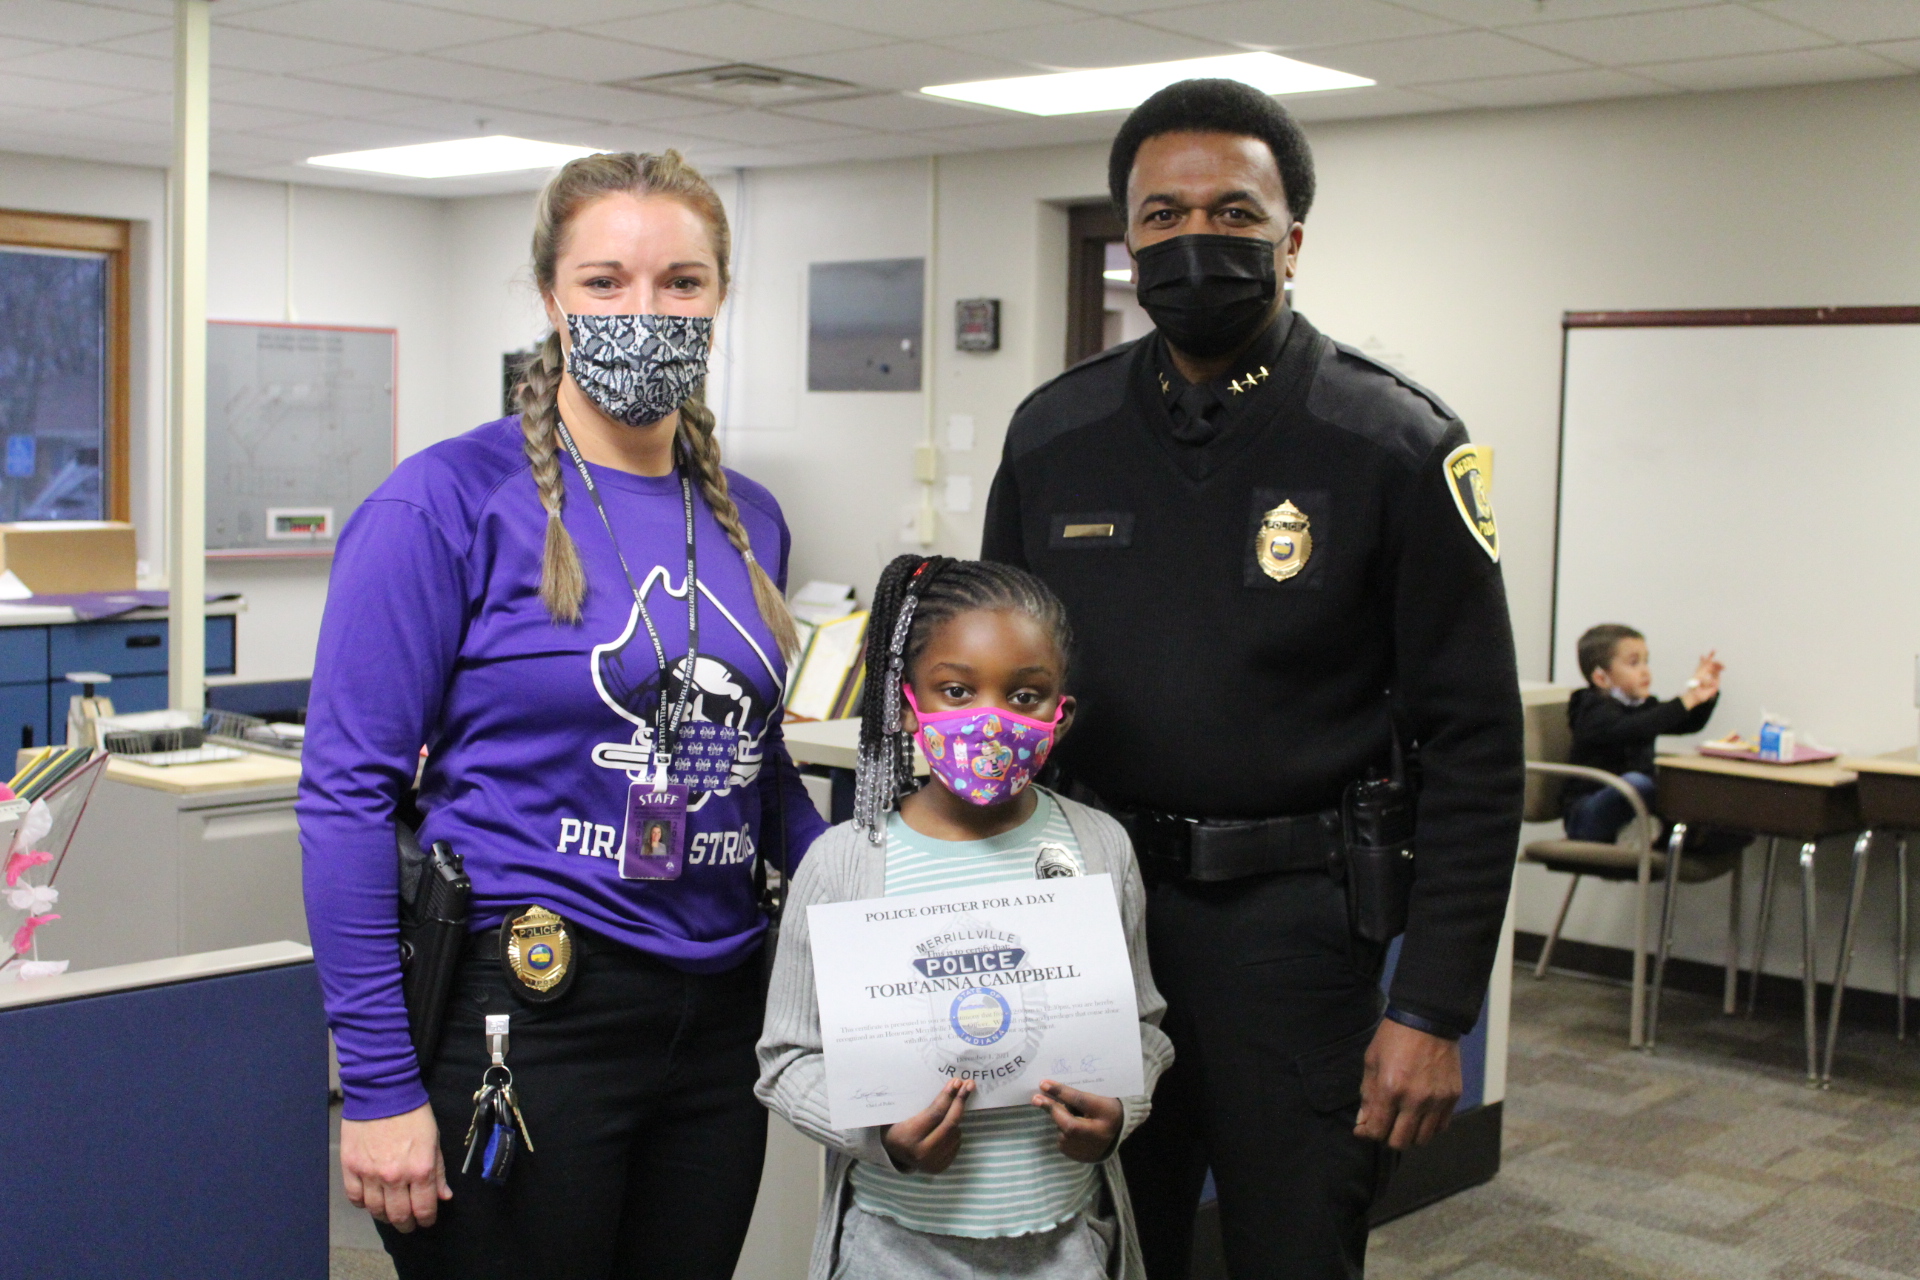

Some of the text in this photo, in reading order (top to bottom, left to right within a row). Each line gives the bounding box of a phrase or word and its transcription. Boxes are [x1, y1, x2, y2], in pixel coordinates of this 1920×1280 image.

[557, 421, 594, 491] MERRILLVILLE PIRATES
[682, 477, 693, 545] MERRILLVILLE PIRATES
[688, 582, 696, 631] MERRILLVILLE
[633, 589, 666, 670] MERRILLVILLE PIRATES
[669, 647, 694, 732] MERRILLVILLE PIRATES
[638, 793, 680, 806] STAFF
[865, 893, 1056, 923] POLICE OFFICER FOR A DAY
[519, 925, 557, 939] POLICE
[916, 929, 1015, 954] MERRILLVILLE
[927, 949, 945, 958] This
[946, 949, 954, 957] is
[965, 944, 991, 956] certify
[992, 942, 1011, 952] that:
[926, 951, 1015, 977] POLICE
[978, 964, 1081, 988] CAMPBELL
[957, 987, 1002, 1001] STATE OF
[959, 1030, 1006, 1045] INDIANA
[938, 1055, 1026, 1081] JR OFFICER
